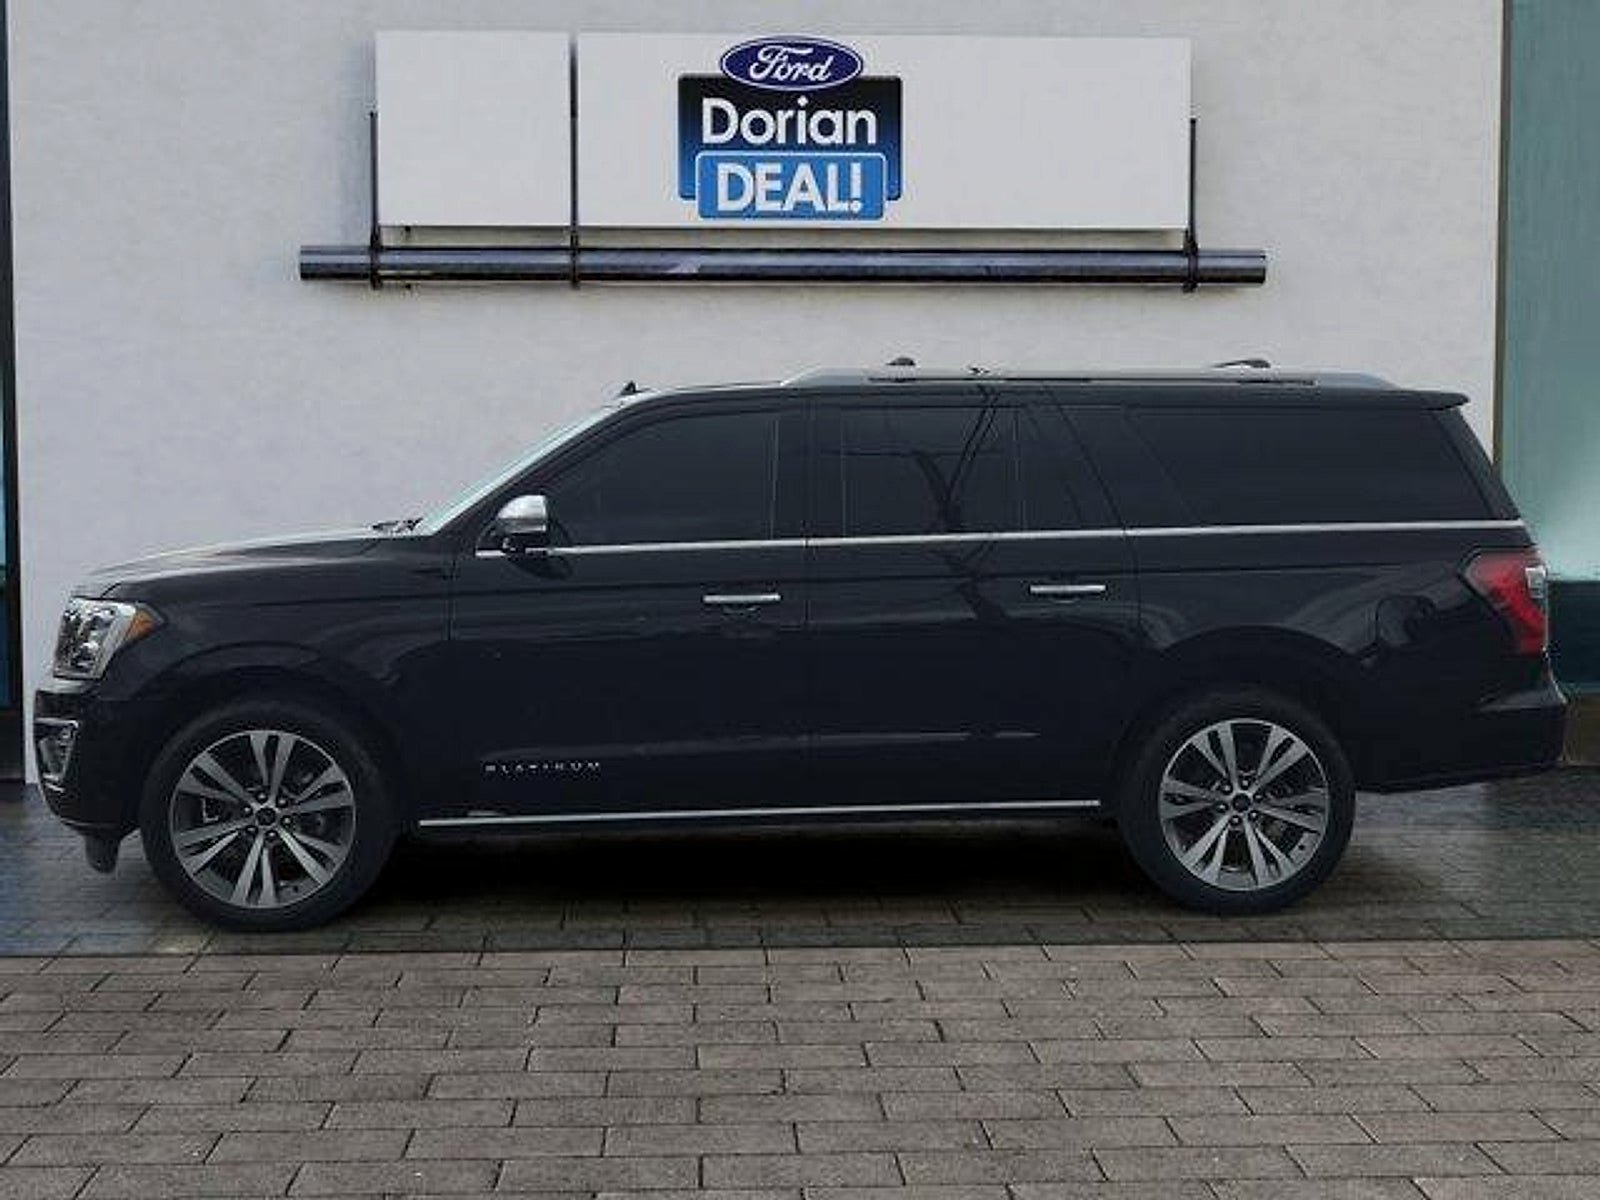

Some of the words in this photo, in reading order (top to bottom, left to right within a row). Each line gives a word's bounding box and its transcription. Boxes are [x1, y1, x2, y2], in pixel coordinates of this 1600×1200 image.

[749, 45, 834, 81] Ford
[702, 96, 876, 144] Dorian
[716, 162, 863, 213] DEAL!
